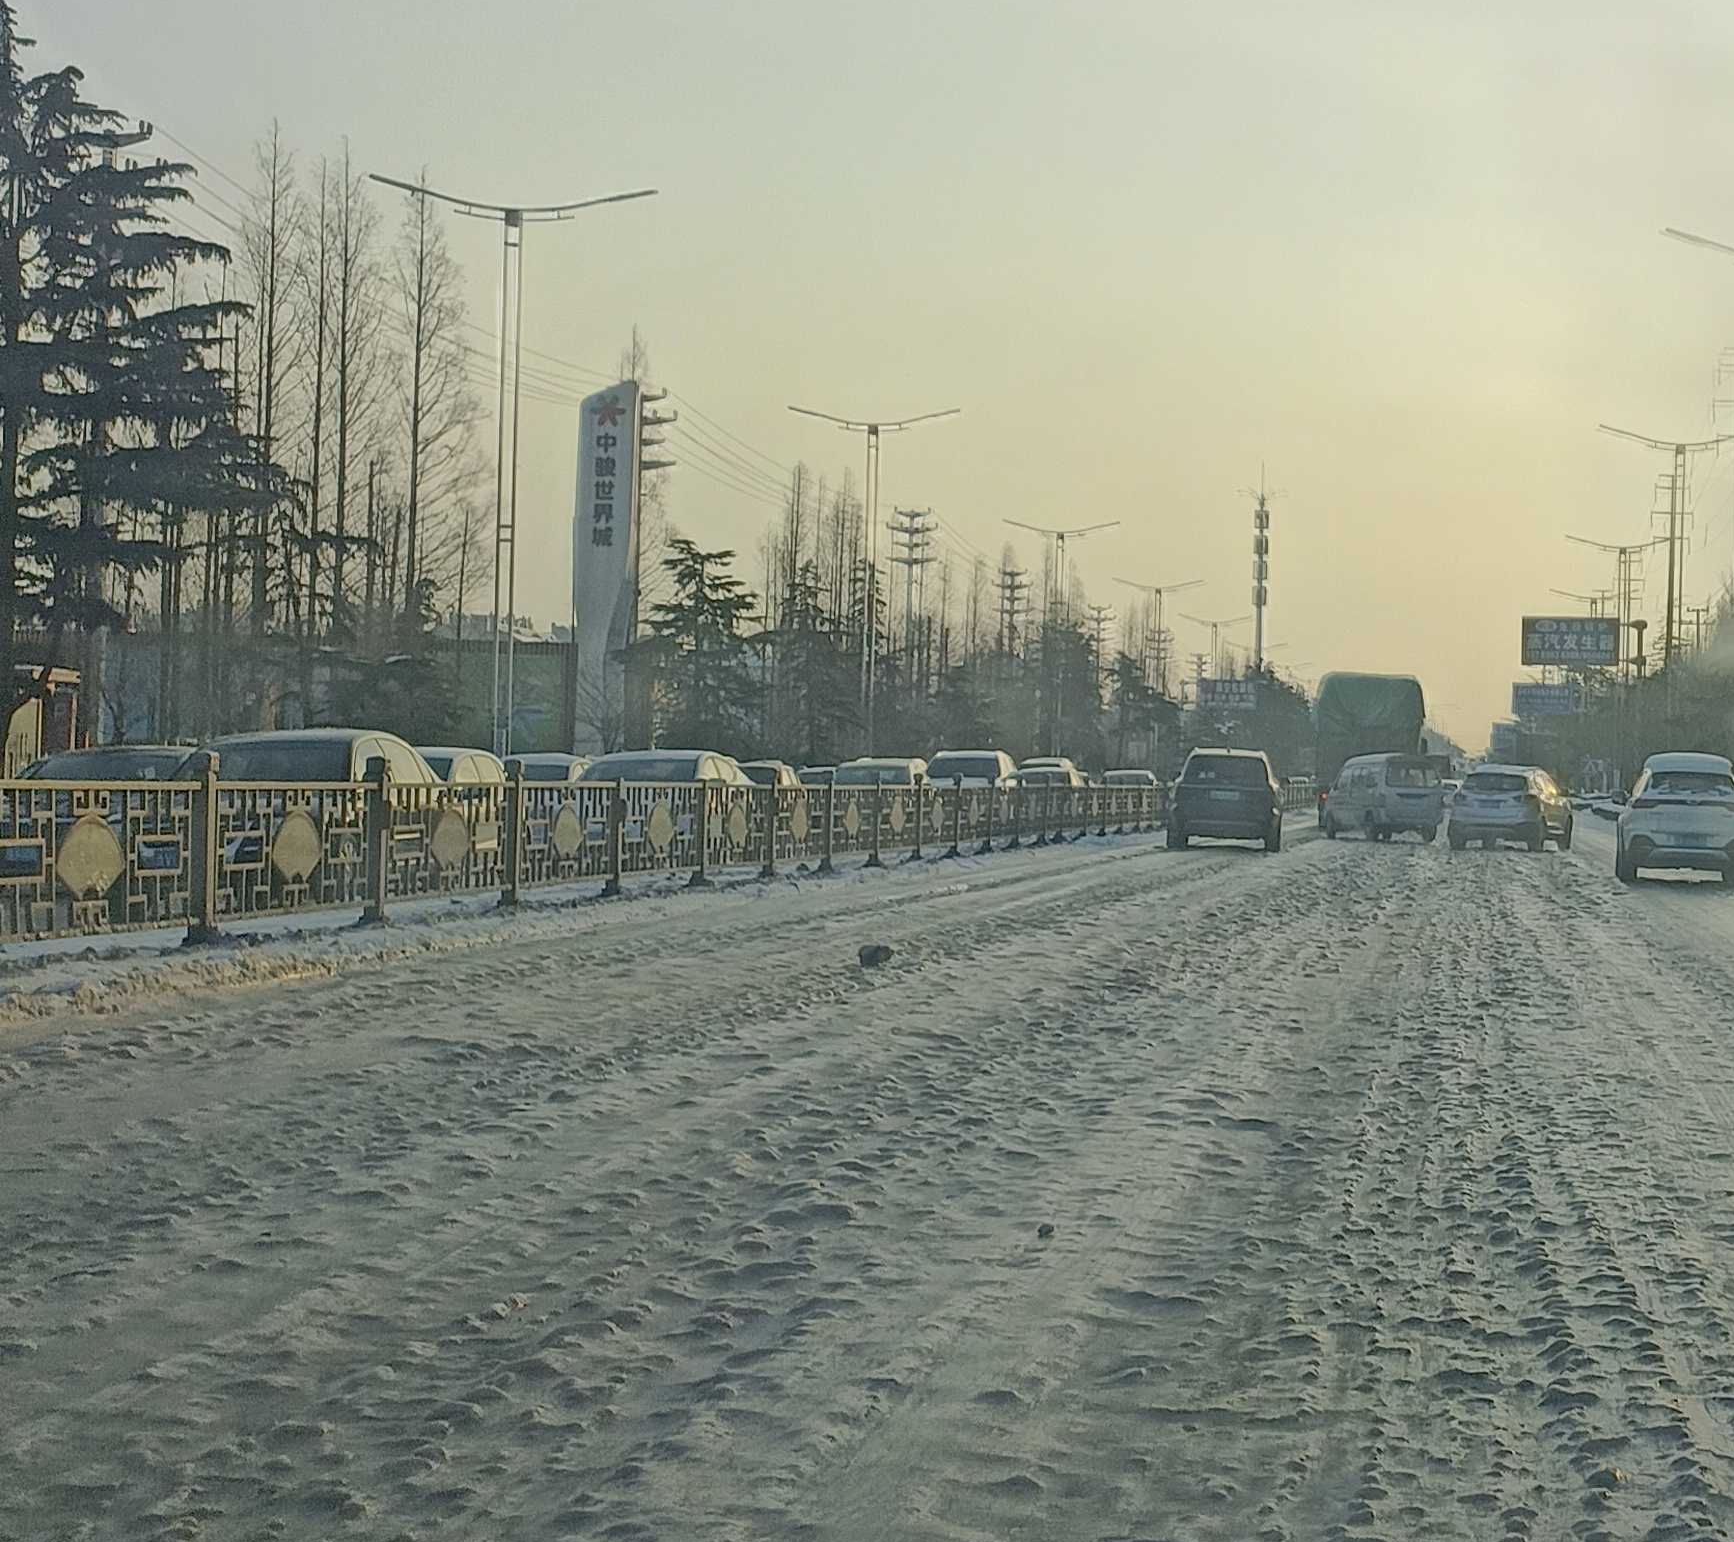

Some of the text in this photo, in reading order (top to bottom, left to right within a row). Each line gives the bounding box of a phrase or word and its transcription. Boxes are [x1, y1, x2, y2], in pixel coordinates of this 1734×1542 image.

[591, 432, 617, 547] 中骏世界城
[1526, 633, 1615, 650] 蒸汽发生器
